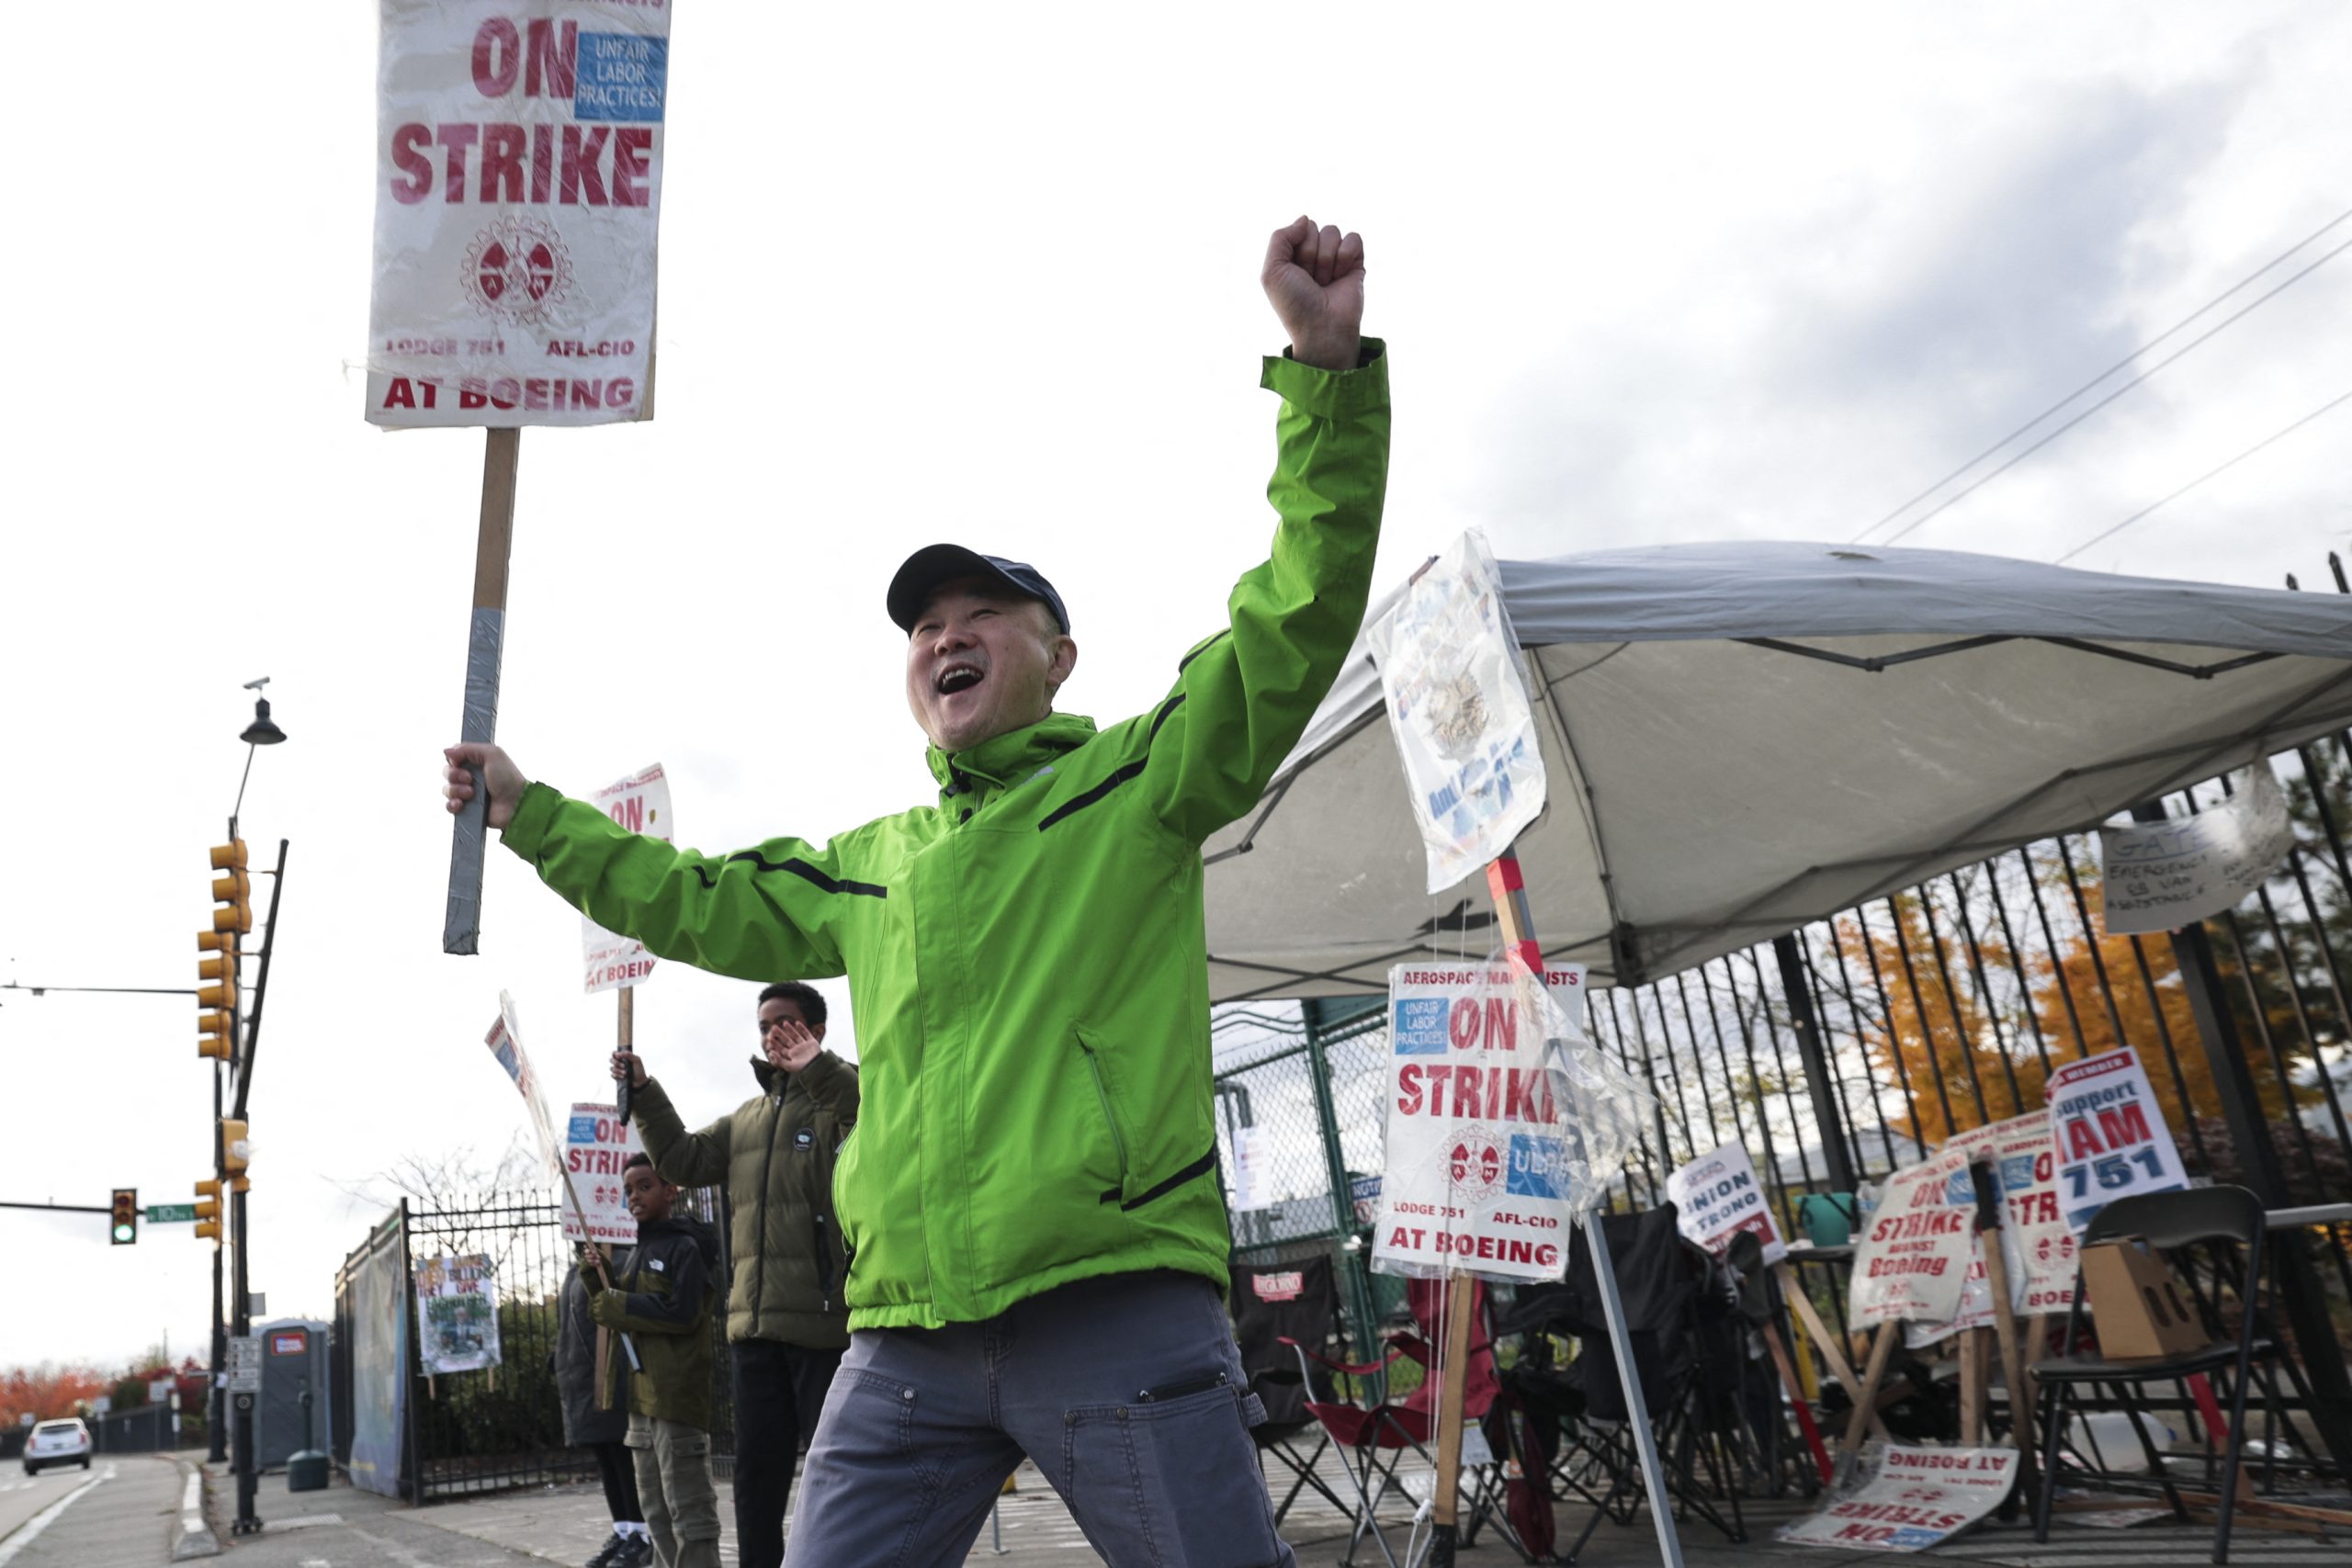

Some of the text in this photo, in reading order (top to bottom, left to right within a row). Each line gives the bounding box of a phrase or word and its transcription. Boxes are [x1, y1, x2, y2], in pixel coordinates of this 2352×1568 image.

[471, 17, 579, 99] ON
[595, 38, 649, 61] UNFAIR
[596, 61, 646, 85] LABOR
[577, 84, 662, 107] PRACTICES!
[390, 122, 653, 208] STRIKE
[386, 338, 636, 356] LODGE 751 AFL-CIO
[383, 378, 634, 412] AT BOEING
[610, 795, 644, 833] ON
[1406, 1001, 1439, 1014] UNFAIR
[1407, 1016, 1437, 1030] LABOR
[1449, 997, 1517, 1051] ON
[2066, 1057, 2125, 1082] MEMBER
[594, 1118, 628, 1145] ON
[2054, 1100, 2154, 1166] IAM
[568, 1147, 638, 1175] STRI
[2034, 1151, 2054, 1183] O
[2061, 1145, 2166, 1199] 751
[1909, 1178, 1949, 1209] ON
[1393, 1201, 1558, 1229] LODGE 751 AFL-CIO
[1871, 1211, 1965, 1242] STRIKE
[565, 1224, 582, 1235] AT
[1388, 1226, 1426, 1250] AT
[1435, 1231, 1558, 1267] BOEING
[1868, 1256, 1949, 1279] Boeing
[1889, 1452, 2009, 1472] AT BOEING
[1829, 1502, 1965, 1529] STRIKE
[1833, 1523, 1896, 1541] ON
